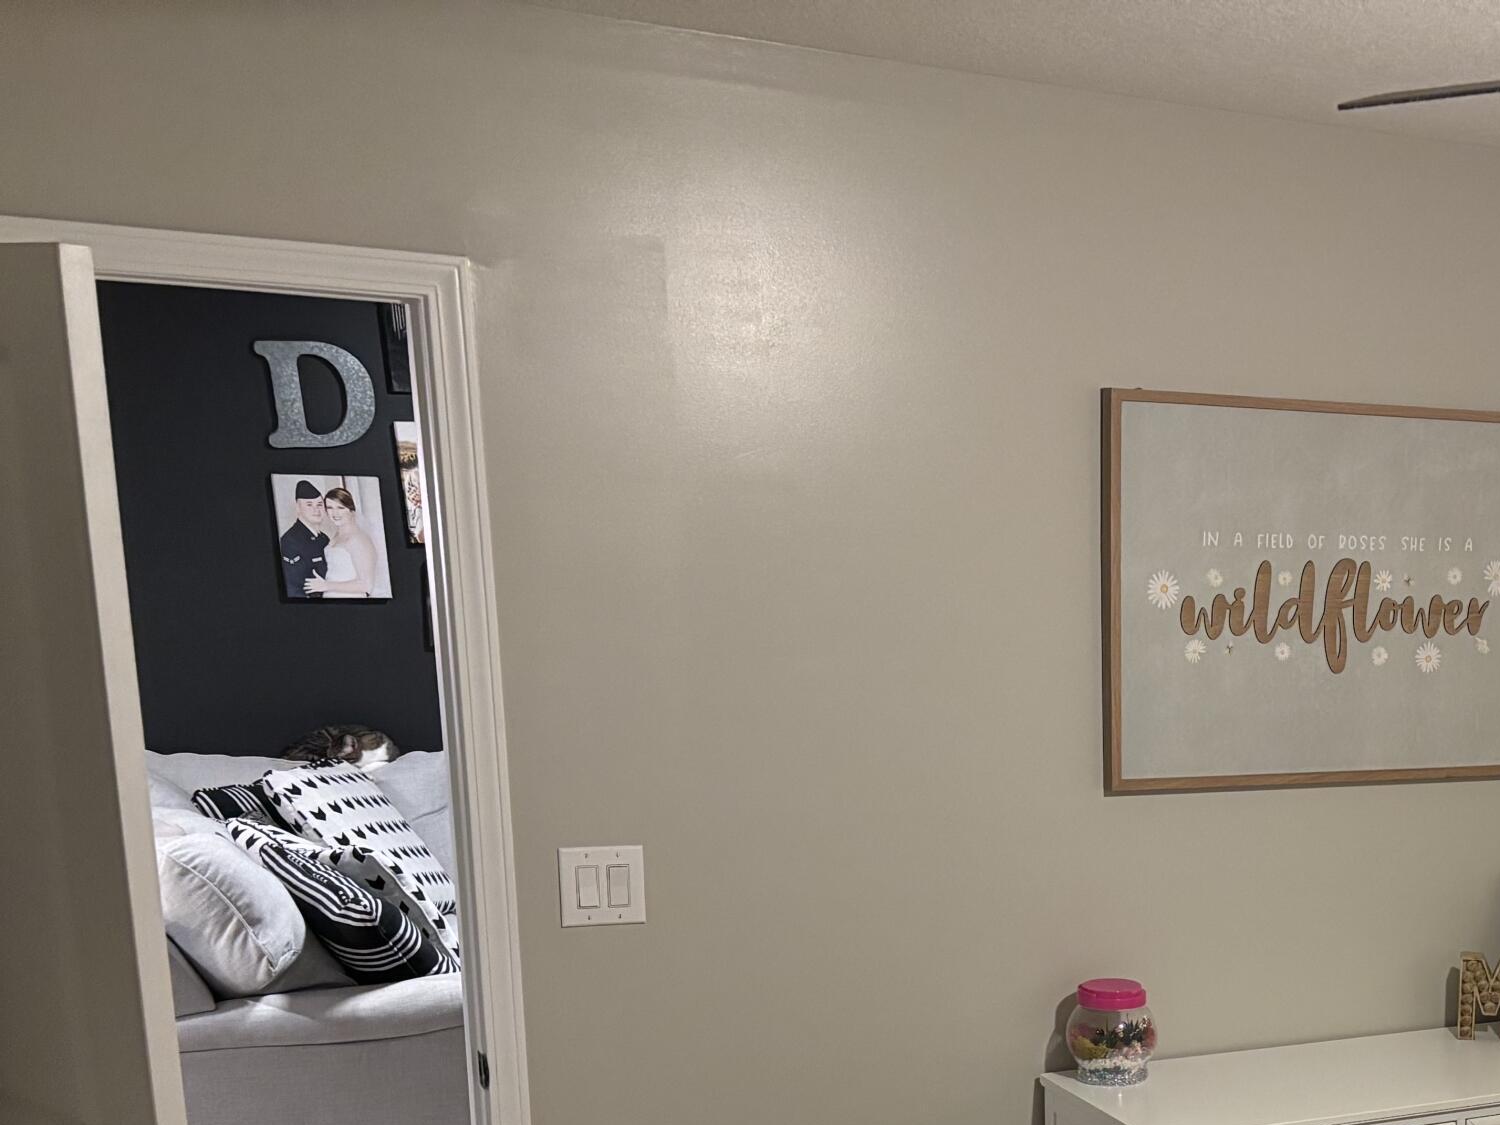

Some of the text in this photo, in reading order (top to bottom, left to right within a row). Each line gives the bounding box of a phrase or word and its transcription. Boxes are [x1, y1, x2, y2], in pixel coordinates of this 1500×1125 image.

[254, 340, 375, 448] D
[1202, 531, 1473, 552] IN A FIELD OF ROSES SHE IS A
[1180, 558, 1490, 674] wildflower
